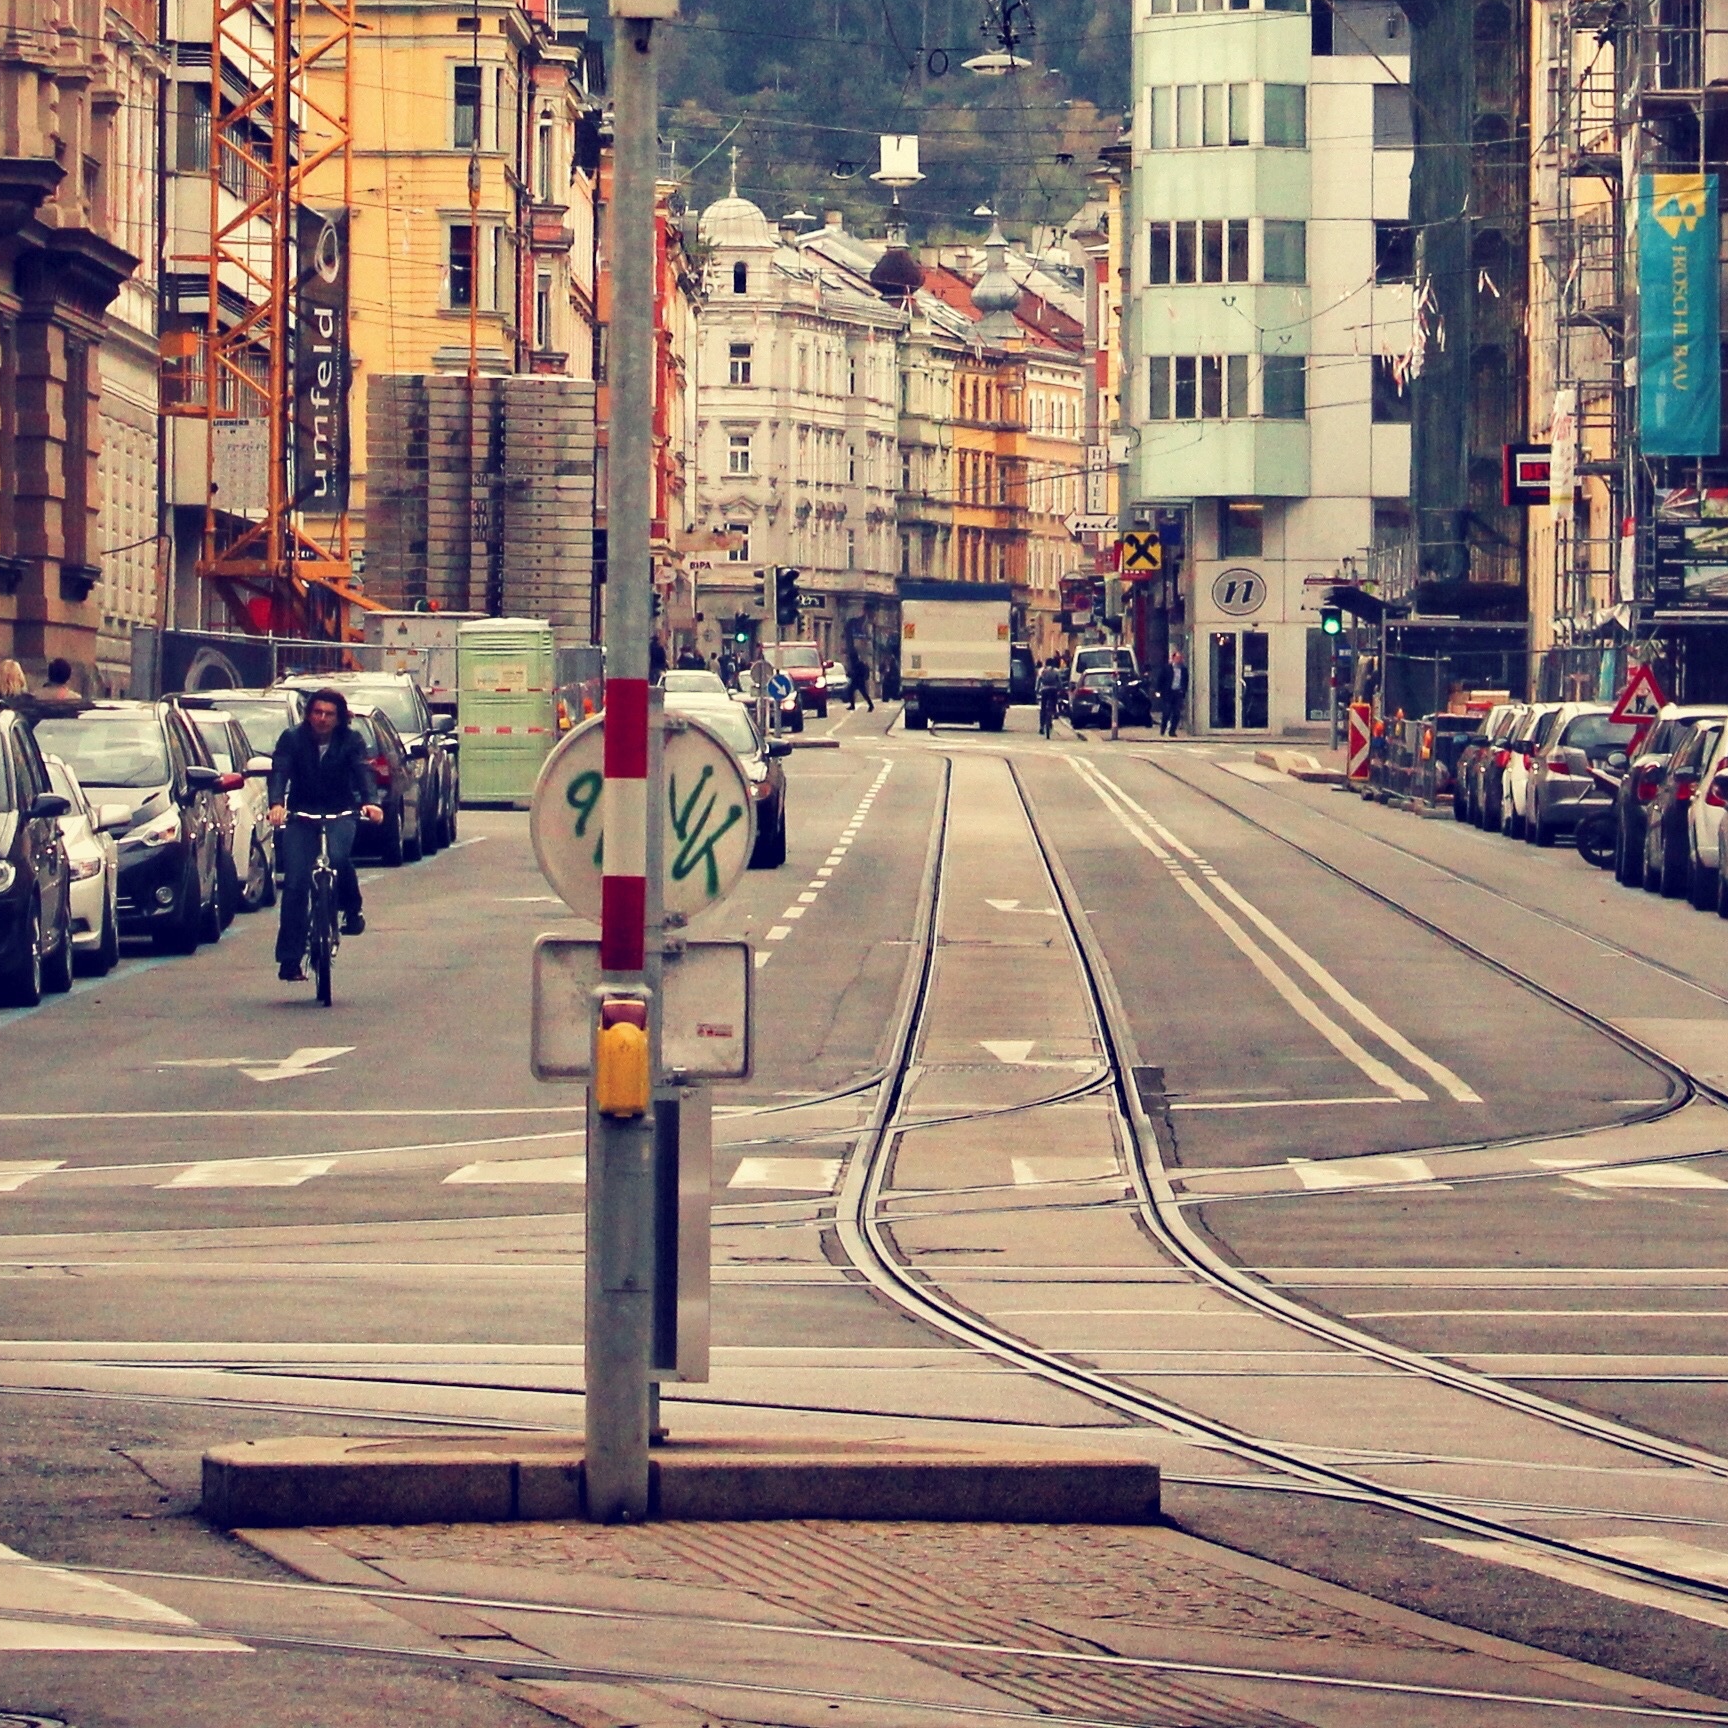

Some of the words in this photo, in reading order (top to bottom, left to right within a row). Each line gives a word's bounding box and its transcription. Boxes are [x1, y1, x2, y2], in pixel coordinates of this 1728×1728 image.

[310, 308, 334, 498] umfeld
[1092, 449, 1103, 509] HOTEL
[689, 561, 712, 570] BIPA
